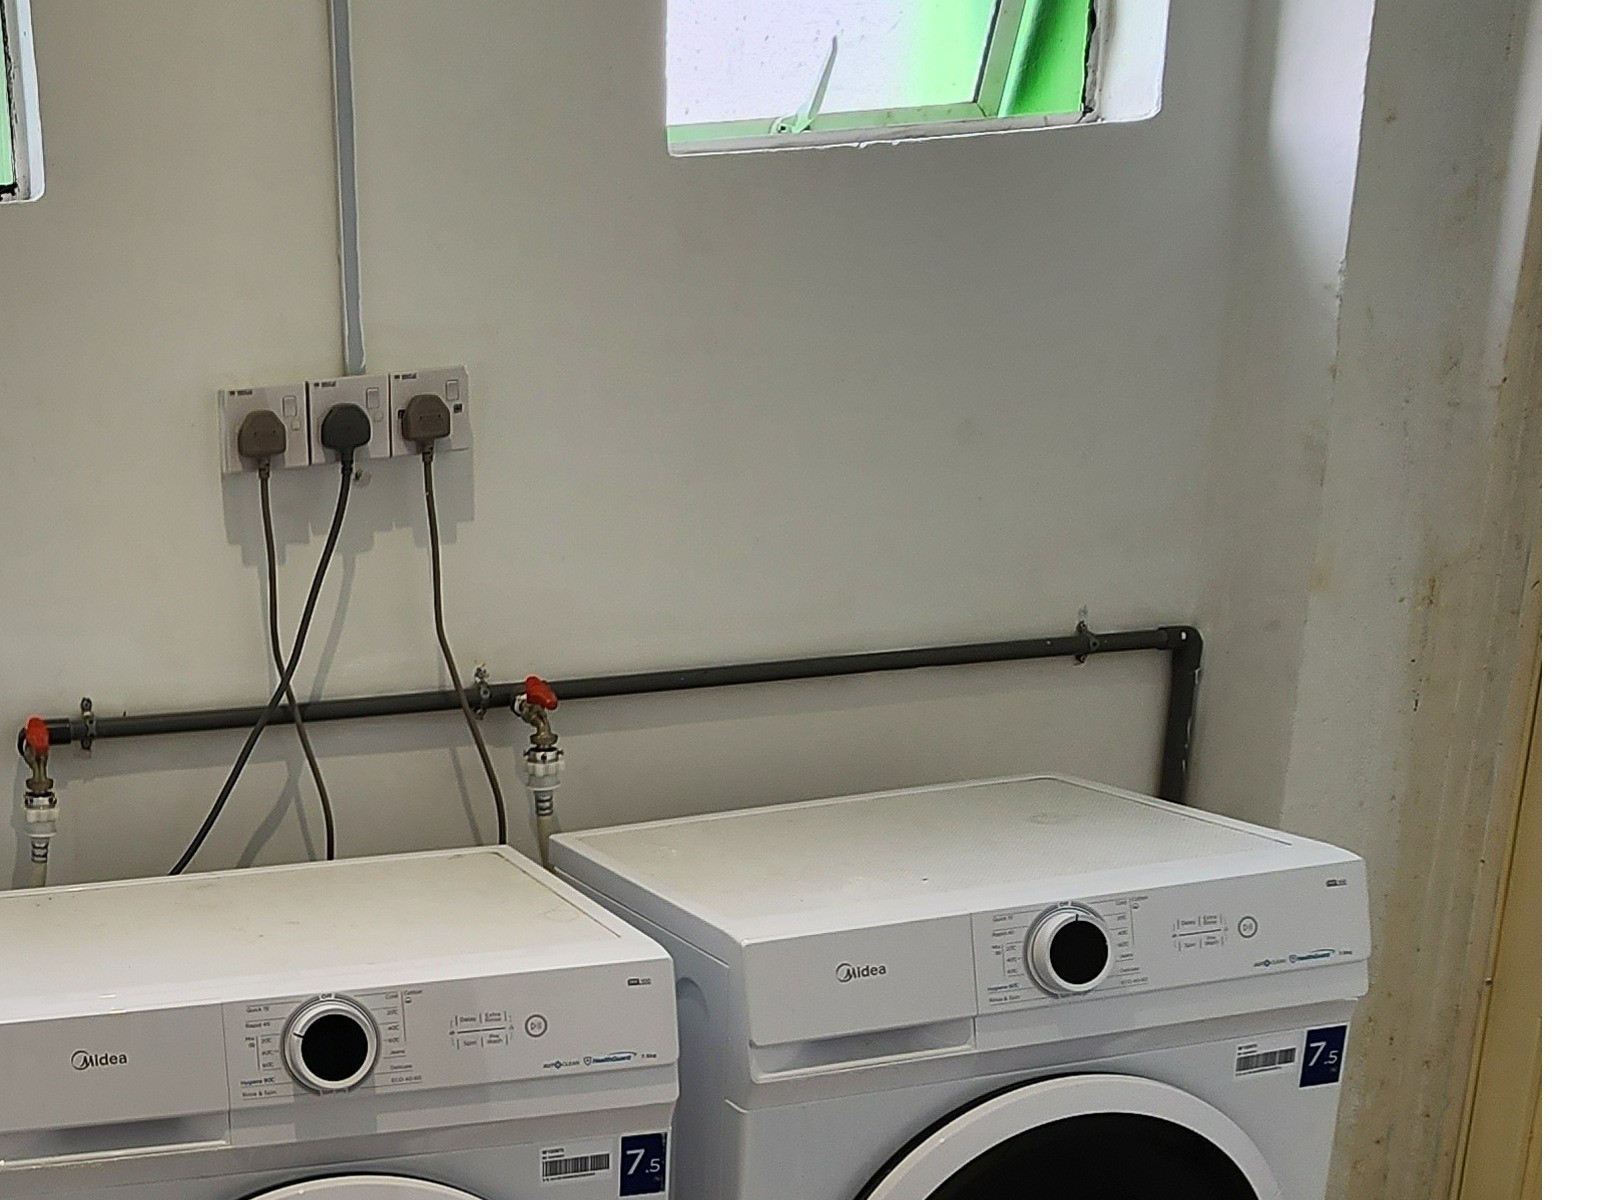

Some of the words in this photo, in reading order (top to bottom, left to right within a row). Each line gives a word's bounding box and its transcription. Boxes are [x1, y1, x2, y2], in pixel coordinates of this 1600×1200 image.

[835, 963, 887, 982] Midea
[71, 1050, 127, 1070] Midea
[626, 1148, 660, 1175] 7.5
